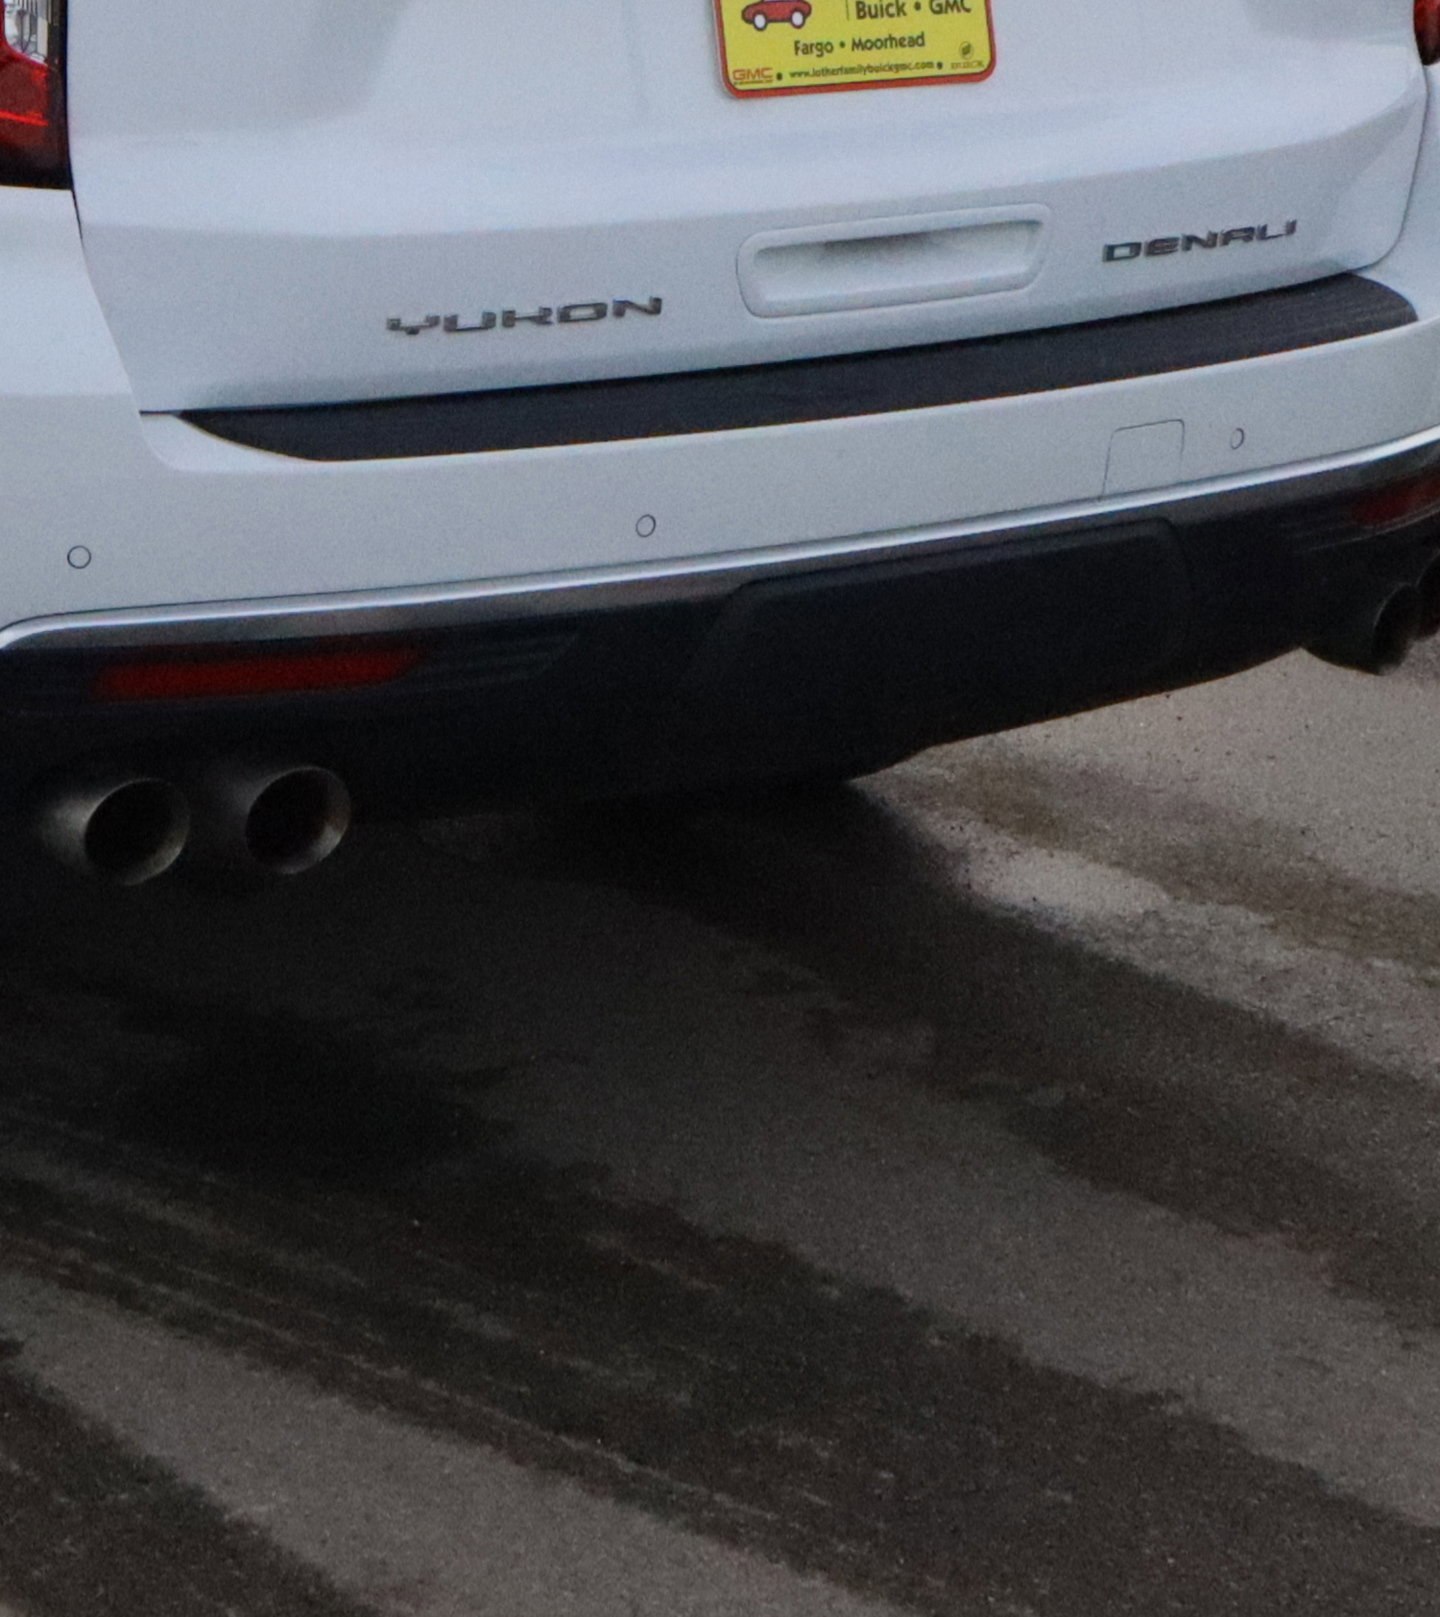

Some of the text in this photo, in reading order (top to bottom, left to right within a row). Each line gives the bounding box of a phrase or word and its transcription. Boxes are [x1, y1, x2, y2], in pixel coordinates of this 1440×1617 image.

[794, 31, 926, 58] Fargo Moorhead
[732, 67, 773, 81] GMC
[1102, 219, 1297, 262] DENALI
[386, 296, 663, 335] YUKON
